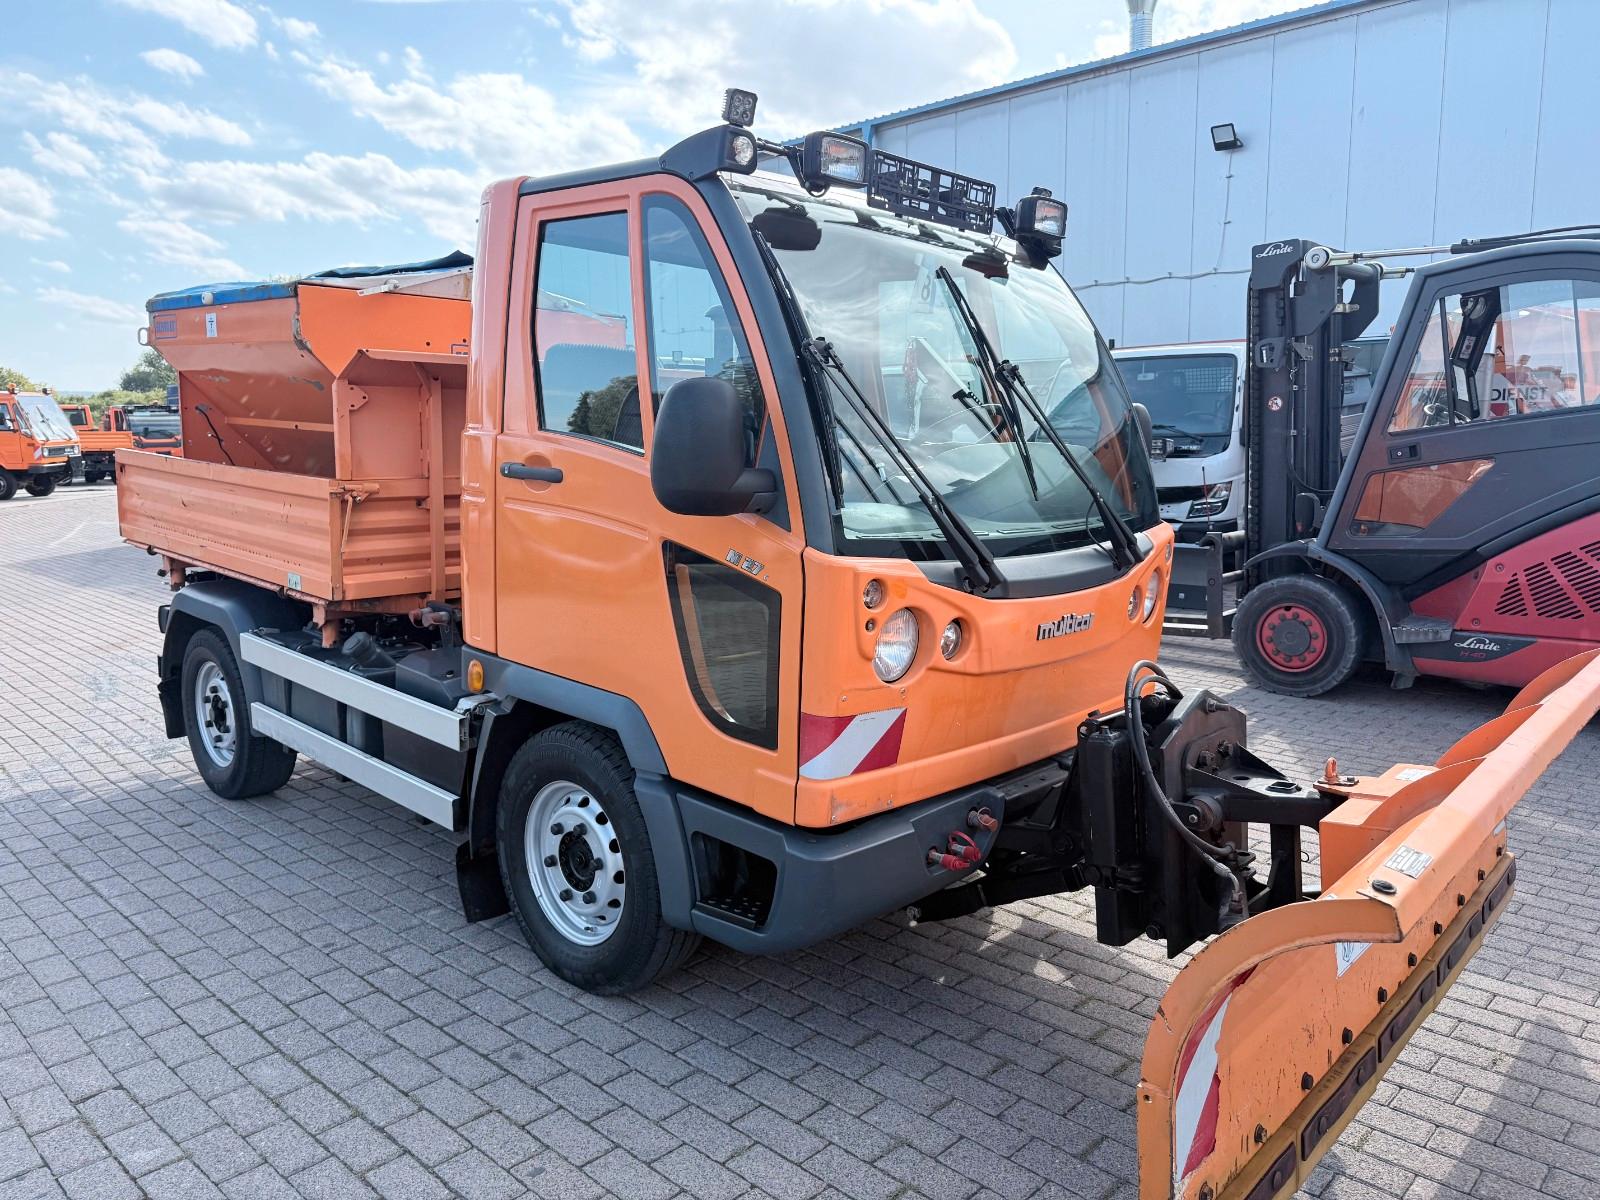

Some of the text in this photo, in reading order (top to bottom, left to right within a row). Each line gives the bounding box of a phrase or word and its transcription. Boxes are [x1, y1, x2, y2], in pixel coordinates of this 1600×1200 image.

[1255, 242, 1294, 258] Linde
[741, 556, 765, 576] 27
[1036, 611, 1096, 641] multicar
[1453, 636, 1501, 651] Linde
